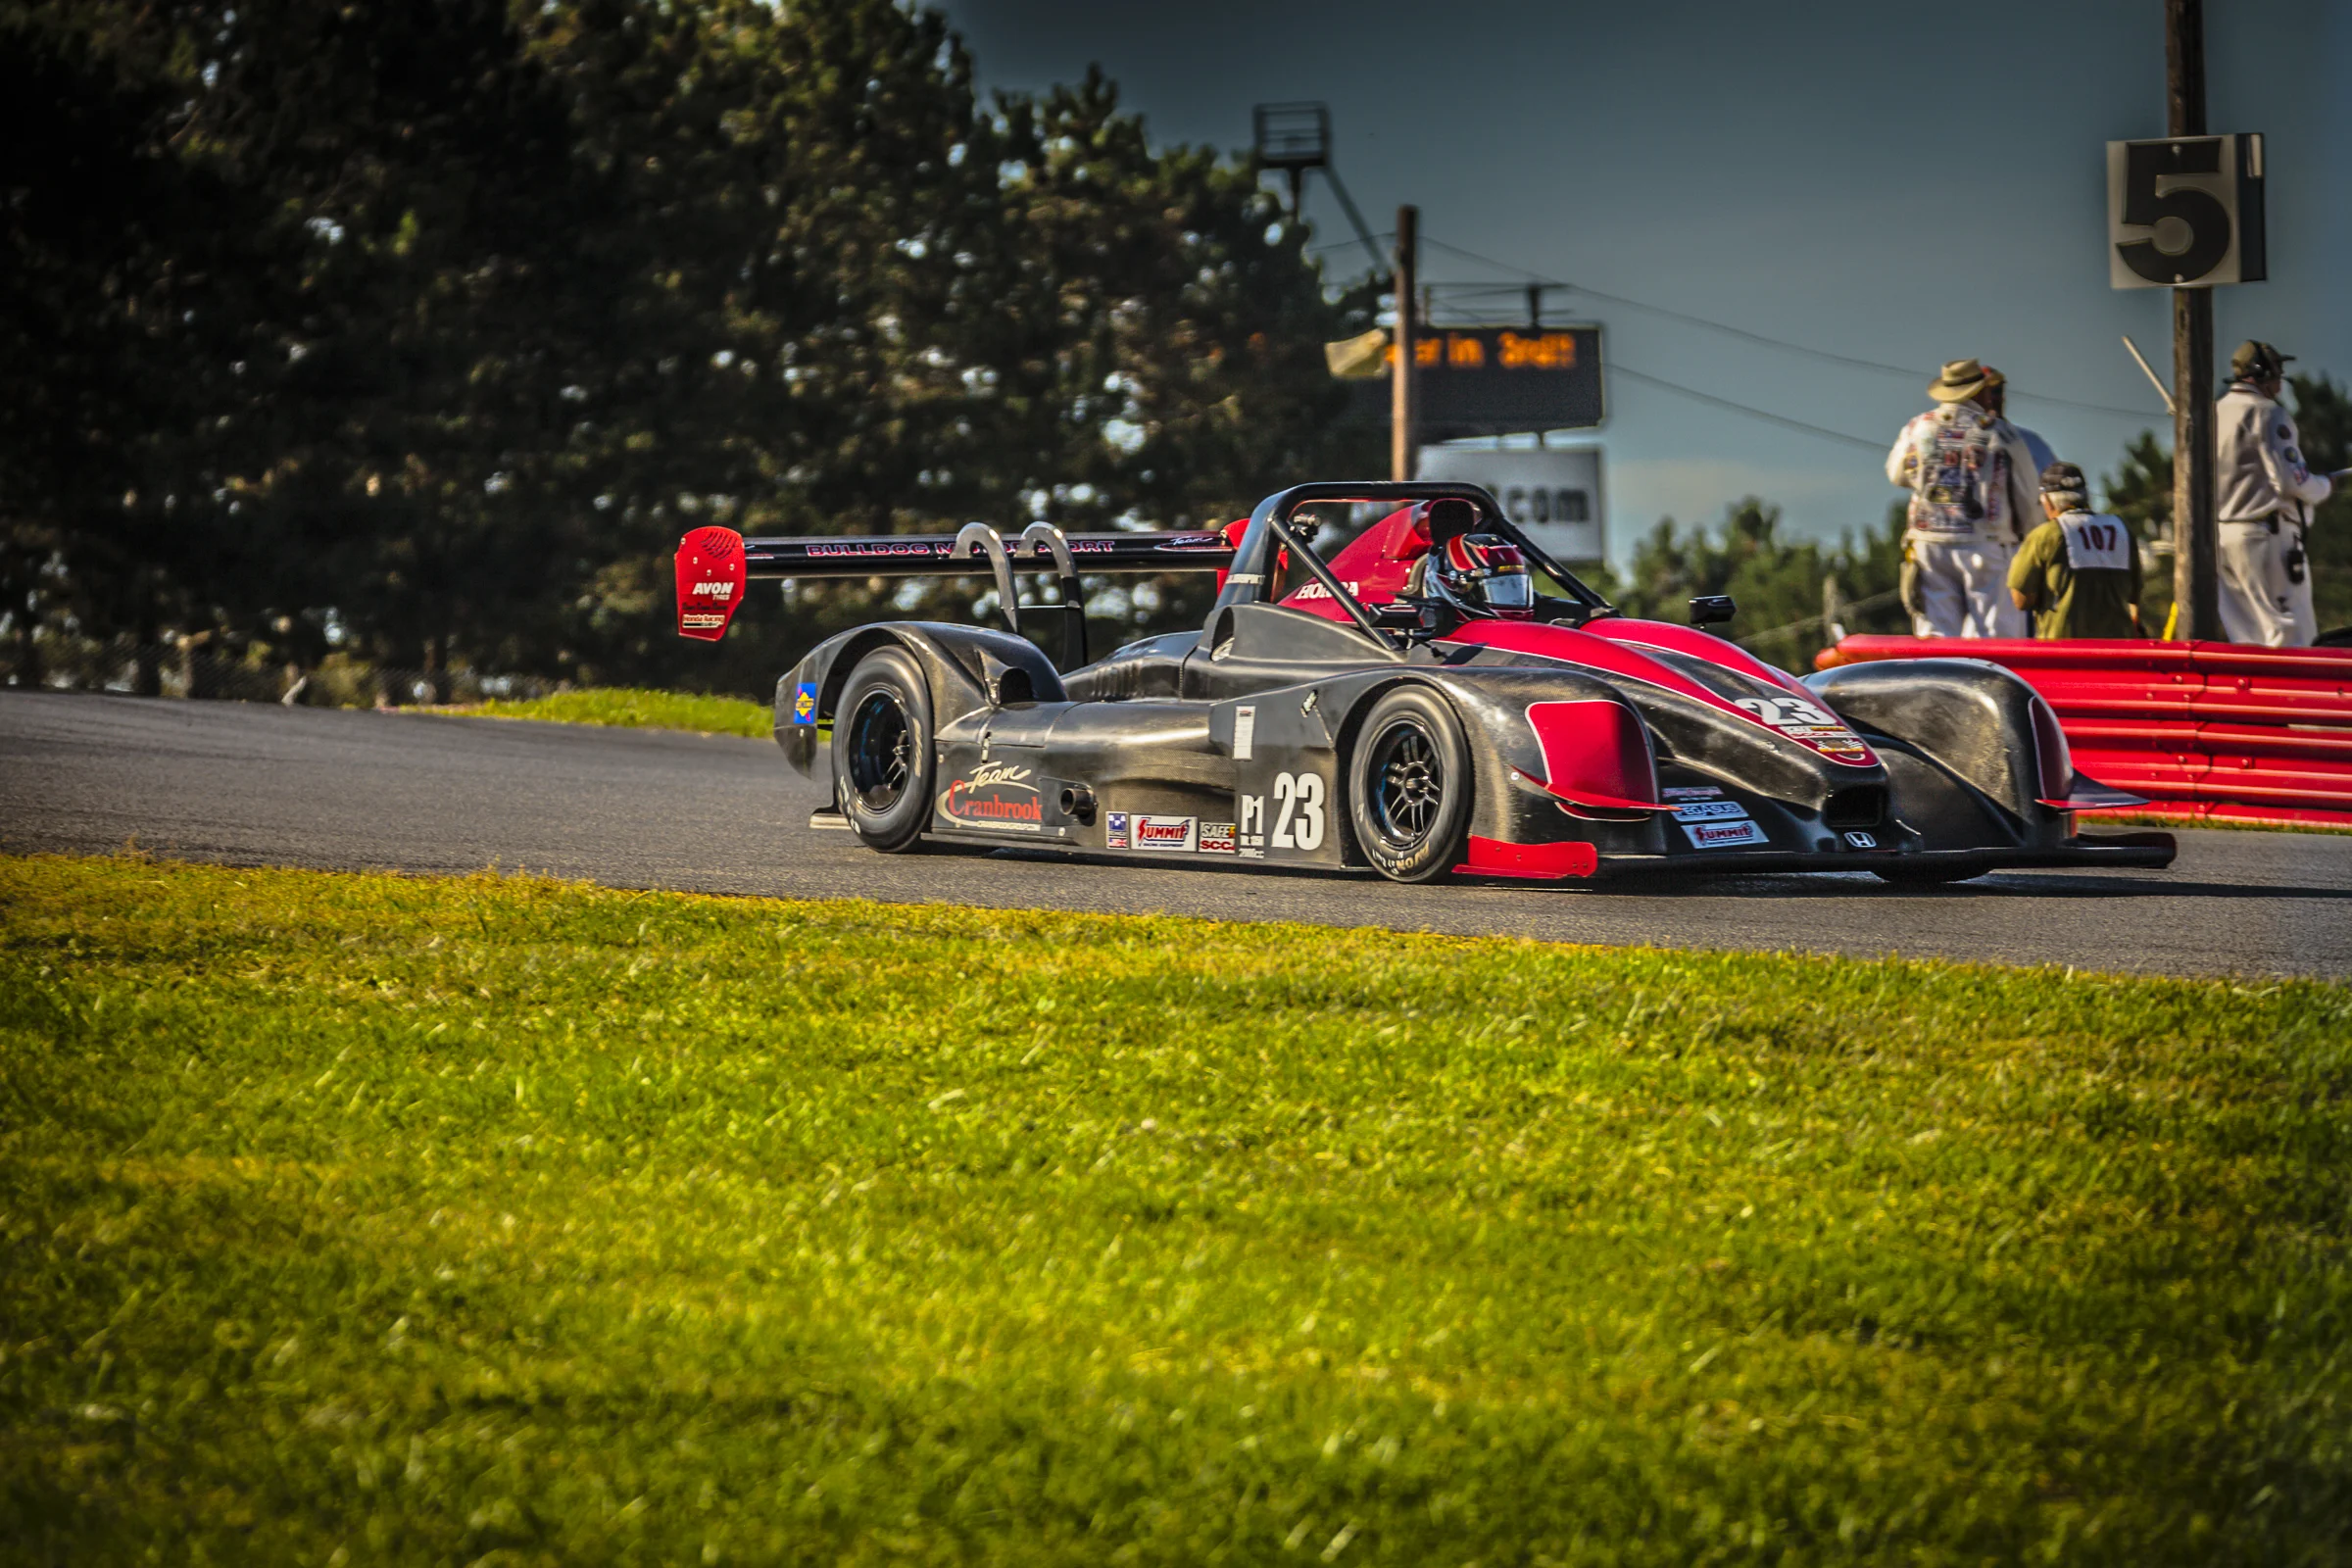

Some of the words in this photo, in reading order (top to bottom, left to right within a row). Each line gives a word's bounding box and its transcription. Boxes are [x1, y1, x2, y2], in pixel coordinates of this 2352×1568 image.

[2115, 137, 2230, 284] 5
[806, 543, 929, 557] BULLDOG
[2078, 524, 2116, 551] 107
[692, 582, 735, 595] AVON
[1734, 697, 1838, 726] 23
[969, 761, 1032, 794] Team
[948, 779, 1043, 820] Cranbrook
[1240, 795, 1265, 834] P1
[1271, 771, 1325, 851] 23
